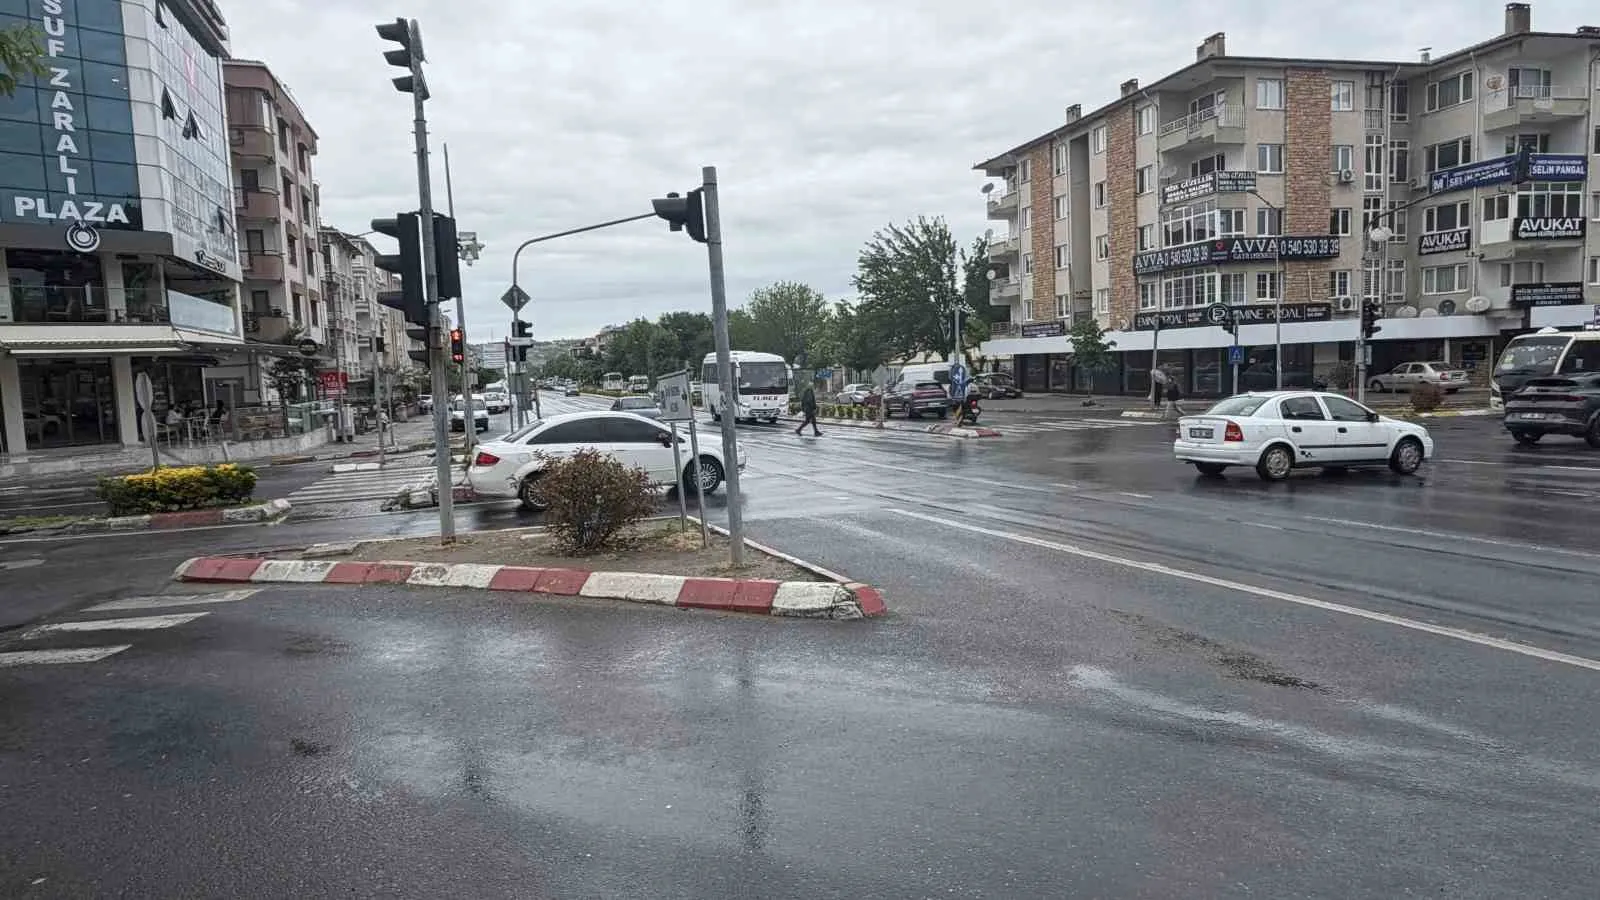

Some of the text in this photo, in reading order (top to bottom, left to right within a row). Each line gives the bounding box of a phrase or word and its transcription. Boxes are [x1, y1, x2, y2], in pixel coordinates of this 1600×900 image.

[14, 196, 130, 224] PLAZA
[1519, 218, 1582, 231] AVUKAT
[1232, 239, 1278, 253] AVVA
[1281, 241, 1287, 255] 0
[1288, 240, 1302, 255] 540
[1304, 240, 1318, 255] 530
[1421, 231, 1467, 248] AVUKAT
[1136, 252, 1164, 268] AVVA
